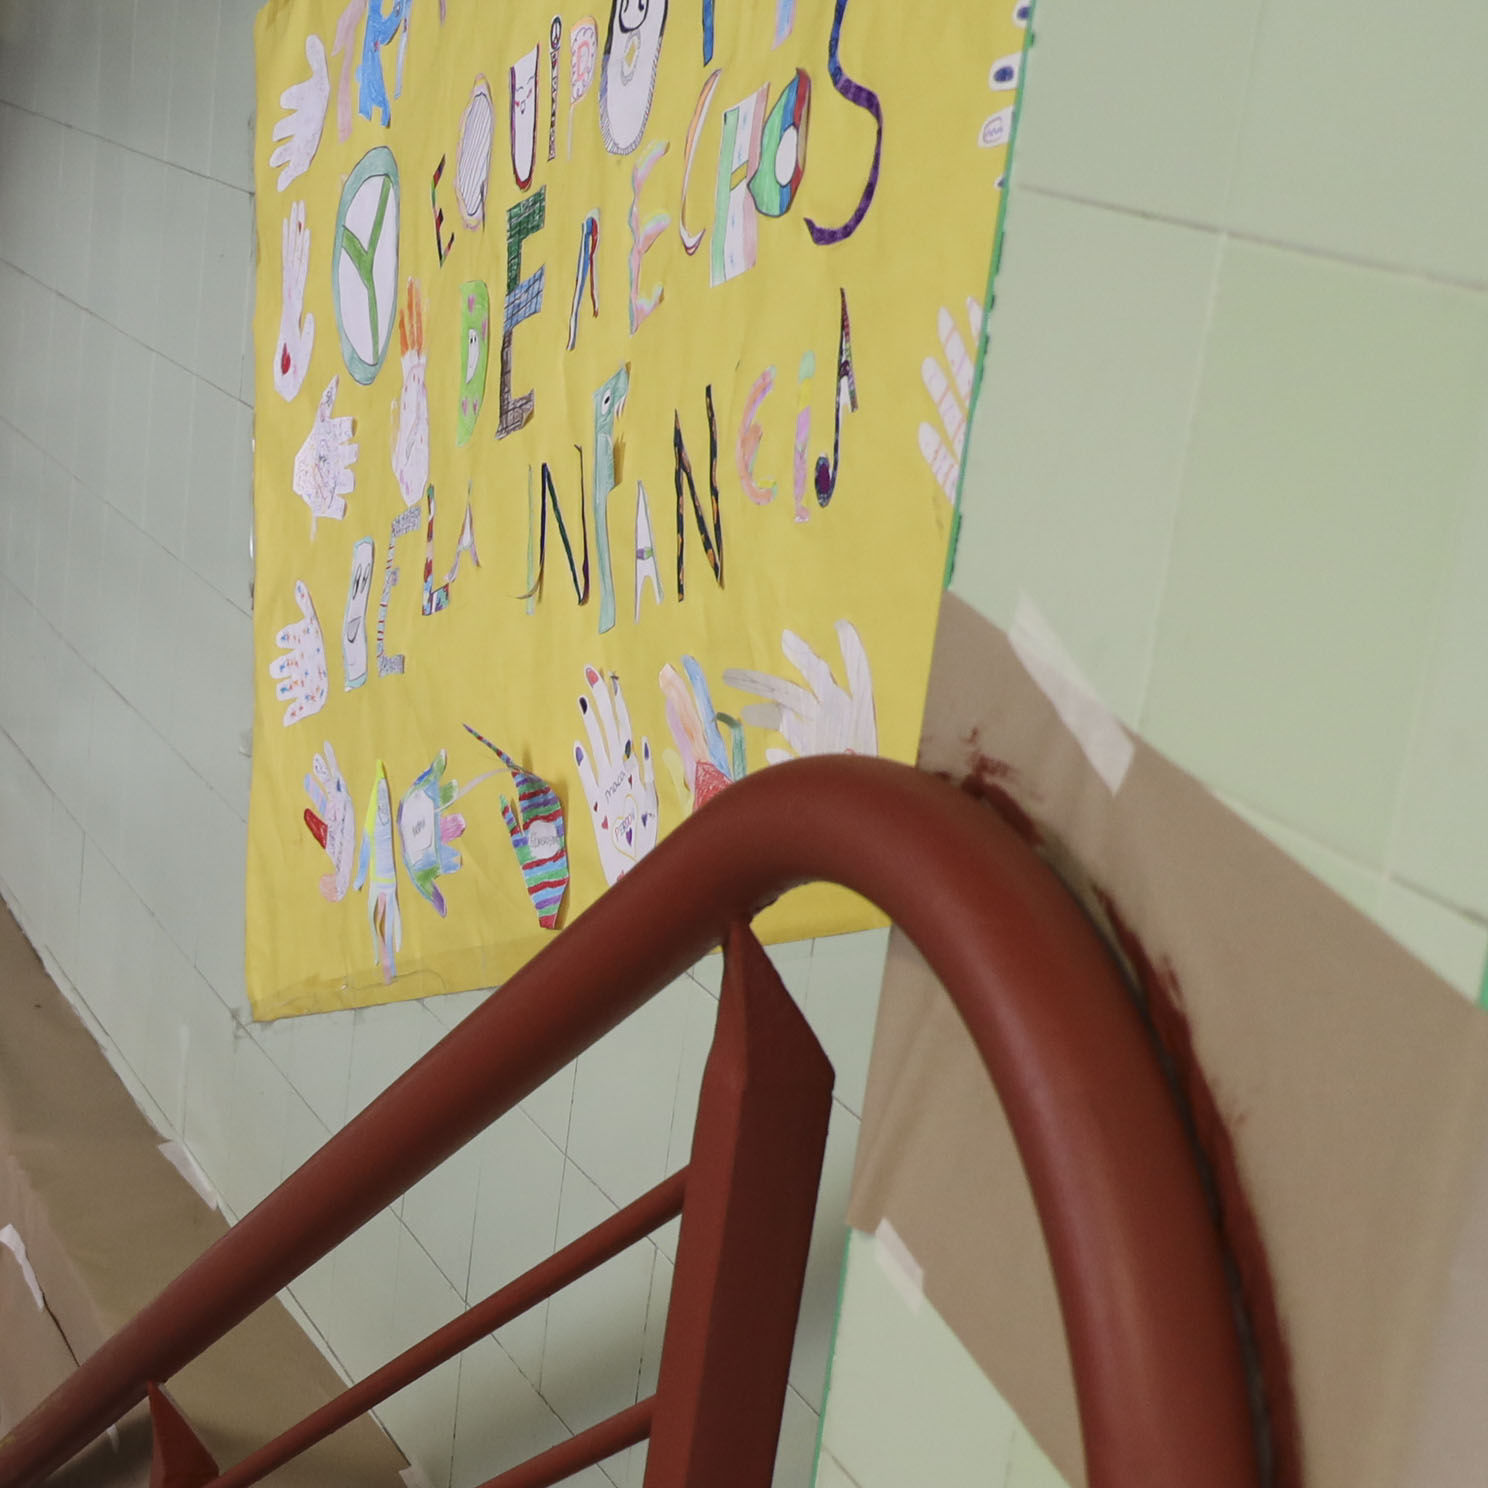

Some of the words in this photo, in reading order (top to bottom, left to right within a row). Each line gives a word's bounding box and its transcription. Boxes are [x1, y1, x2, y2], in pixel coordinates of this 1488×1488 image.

[457, 0, 883, 446] DERECHOS
[343, 505, 421, 693] DE
[422, 480, 480, 617] LA
